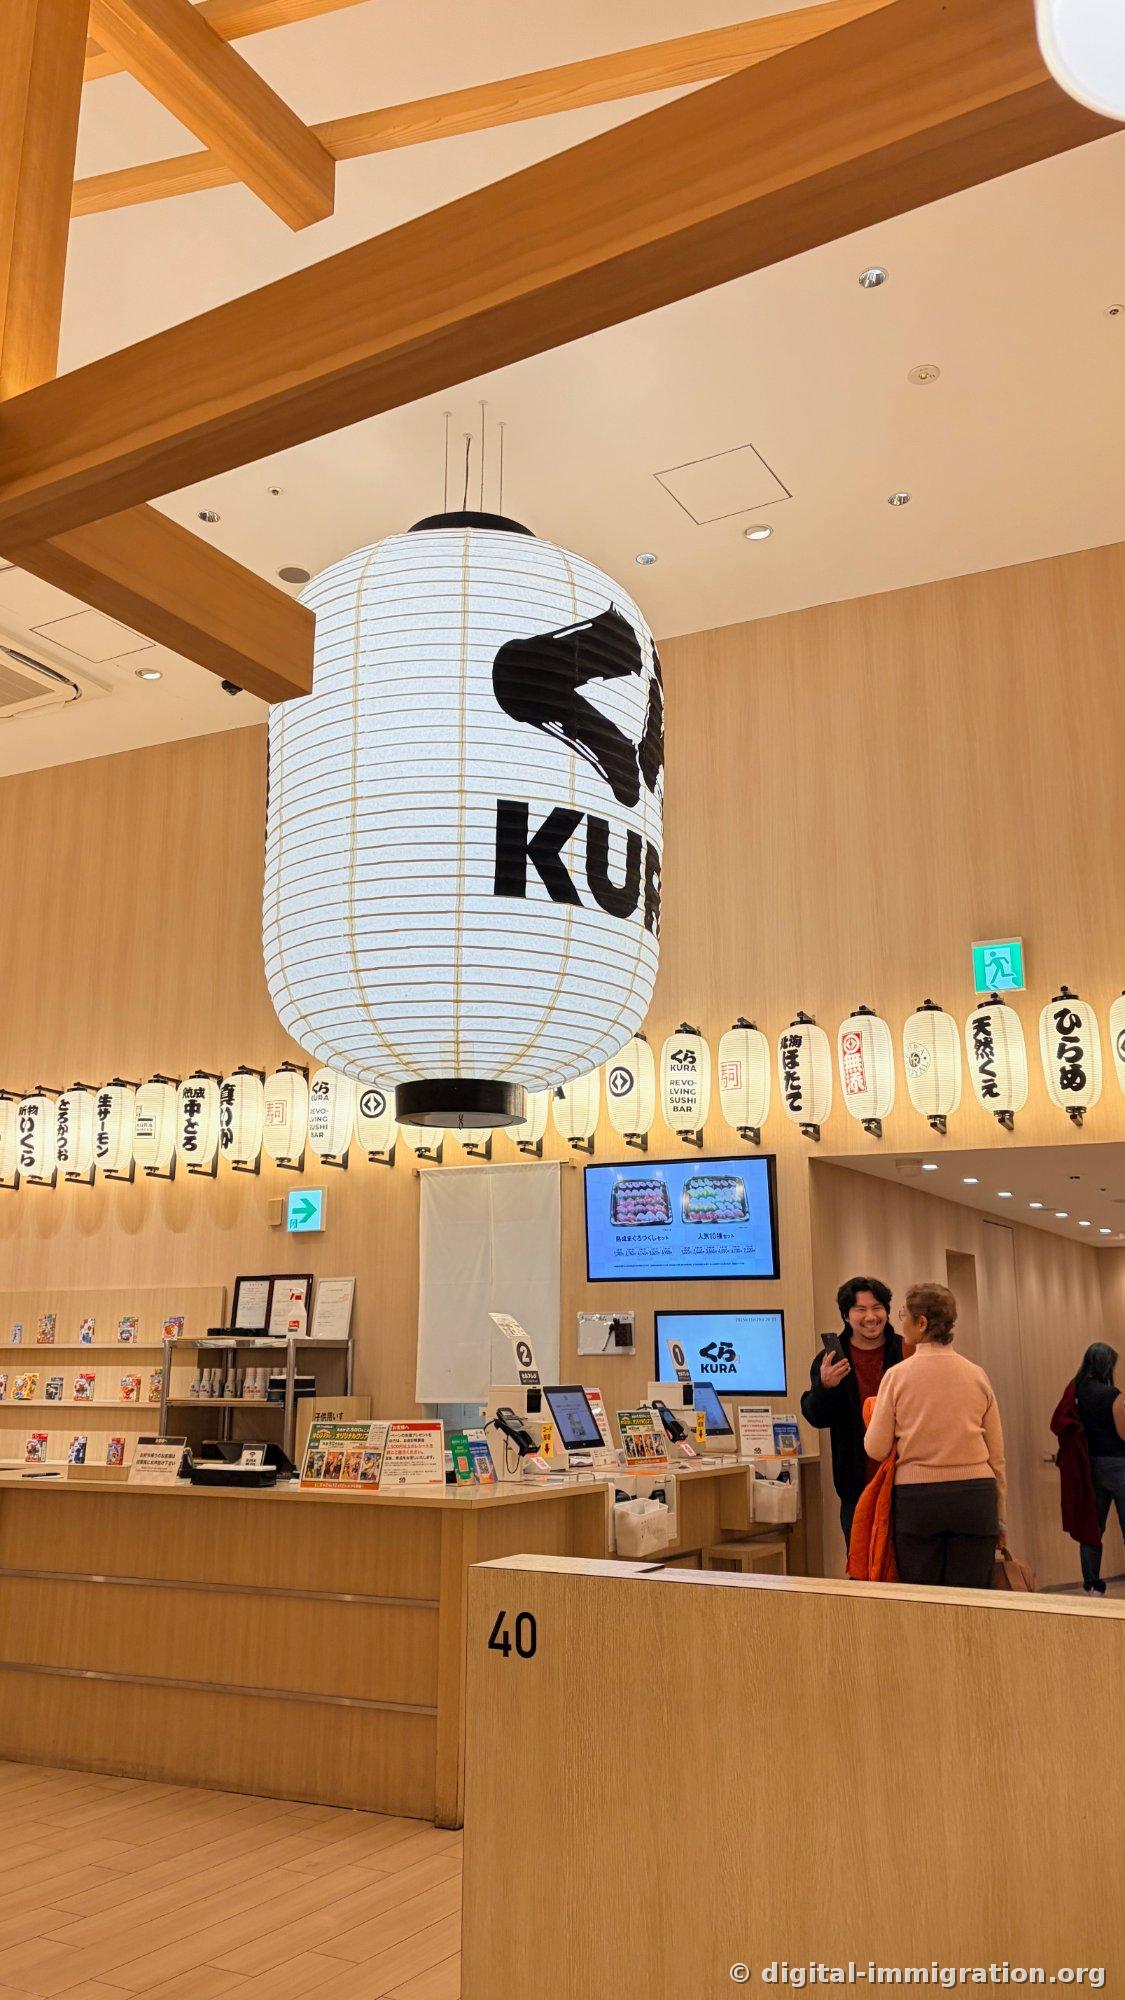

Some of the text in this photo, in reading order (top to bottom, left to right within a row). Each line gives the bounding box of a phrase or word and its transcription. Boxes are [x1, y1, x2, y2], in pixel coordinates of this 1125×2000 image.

[670, 1049, 697, 1064] くら
[971, 1015, 1001, 1099] 天然くえ
[1054, 1007, 1087, 1092] ひらめ
[669, 1079, 697, 1087] REVO-
[670, 1064, 697, 1072] KURA
[782, 1050, 803, 1112] ほたて
[182, 1087, 205, 1099] 熟成
[312, 1081, 330, 1094] くら
[56, 1098, 70, 1162] とろかつお
[96, 1093, 113, 1158] 生サーモン
[182, 1100, 202, 1152] 中とろ
[219, 1083, 236, 1150] 真いか
[19, 1117, 36, 1167] いくら
[519, 1345, 530, 1363] 2
[675, 1347, 683, 1364] 1
[699, 1341, 737, 1362] くら
[700, 1363, 738, 1374] KURA
[487, 1610, 537, 1659] 40
